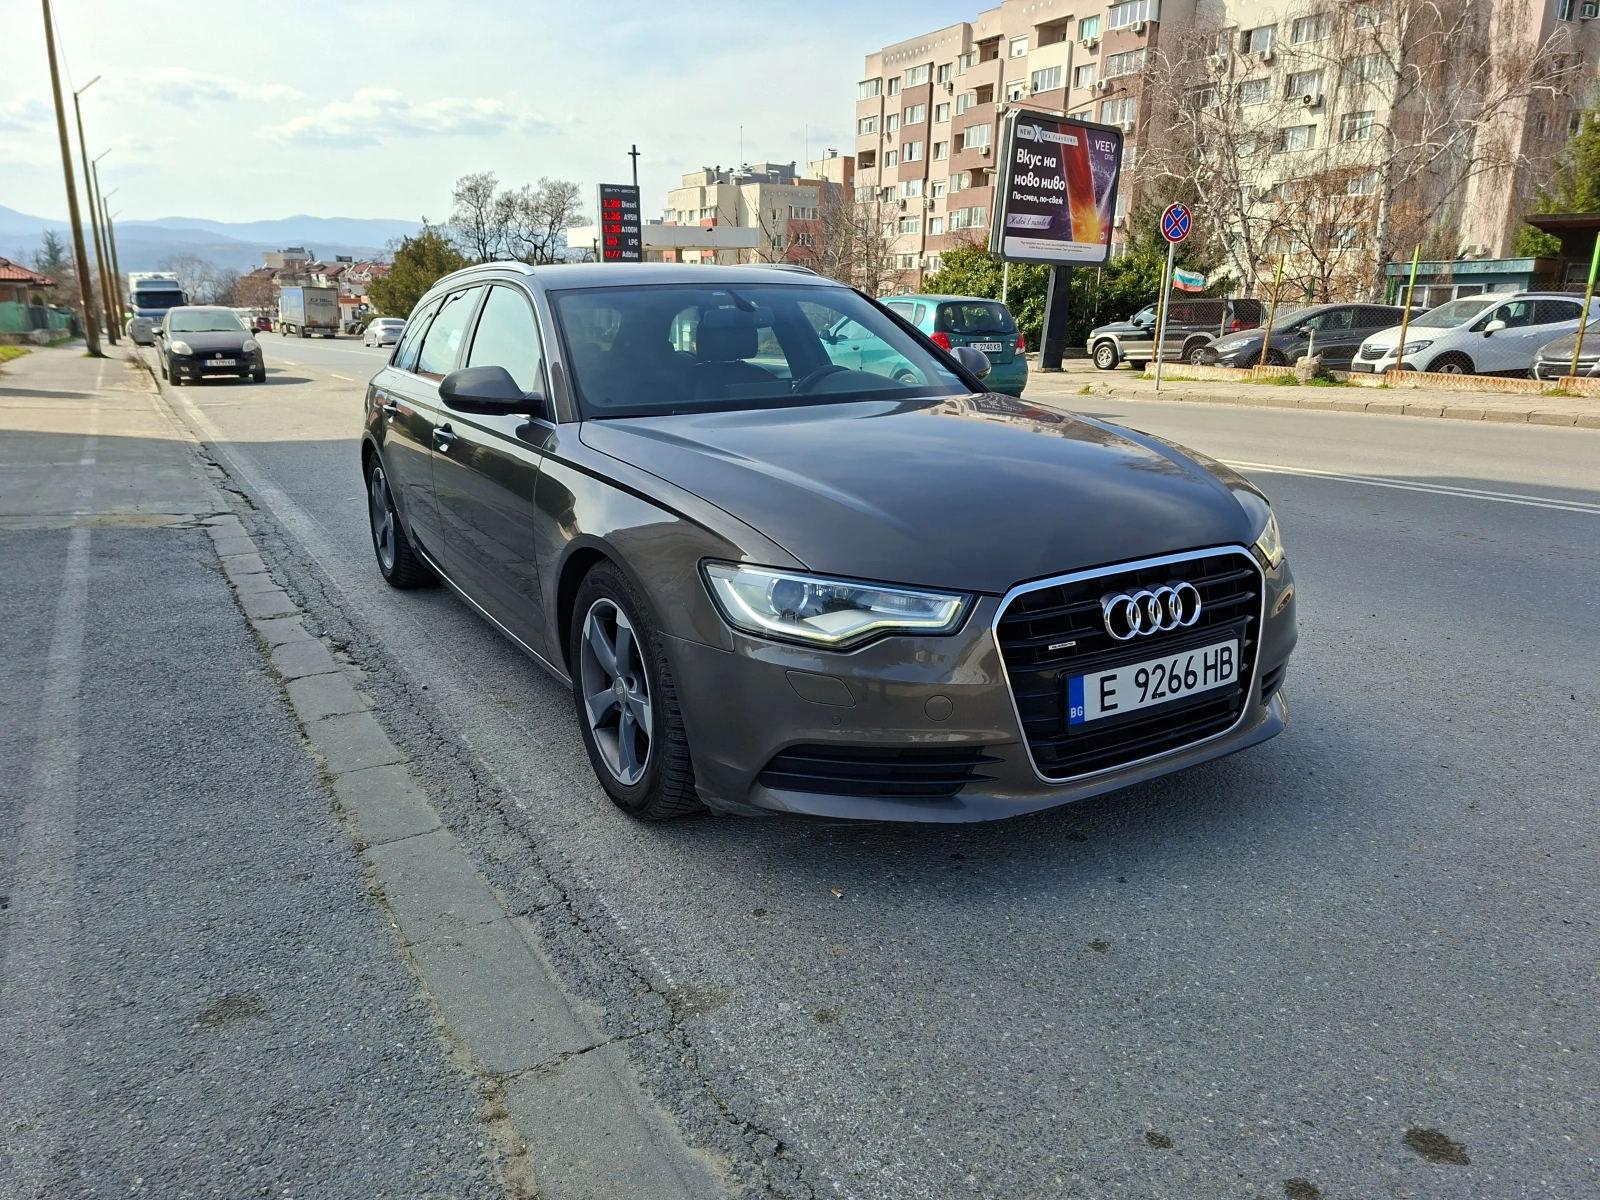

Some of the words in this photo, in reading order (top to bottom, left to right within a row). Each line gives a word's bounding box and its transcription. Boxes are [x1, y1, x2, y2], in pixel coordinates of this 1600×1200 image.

[1052, 134, 1076, 144] FLAVOURS
[1094, 139, 1116, 153] VEEV
[1016, 148, 1042, 169] Вкус
[1044, 156, 1057, 168] на
[1104, 153, 1114, 161] one
[1014, 172, 1040, 187] ново
[1040, 176, 1066, 190] ниво
[1012, 191, 1038, 203] По-смел,
[1100, 674, 1118, 712] E
[1134, 656, 1198, 704] 9266
[1203, 646, 1234, 686] HB
[1070, 706, 1083, 718] BG
